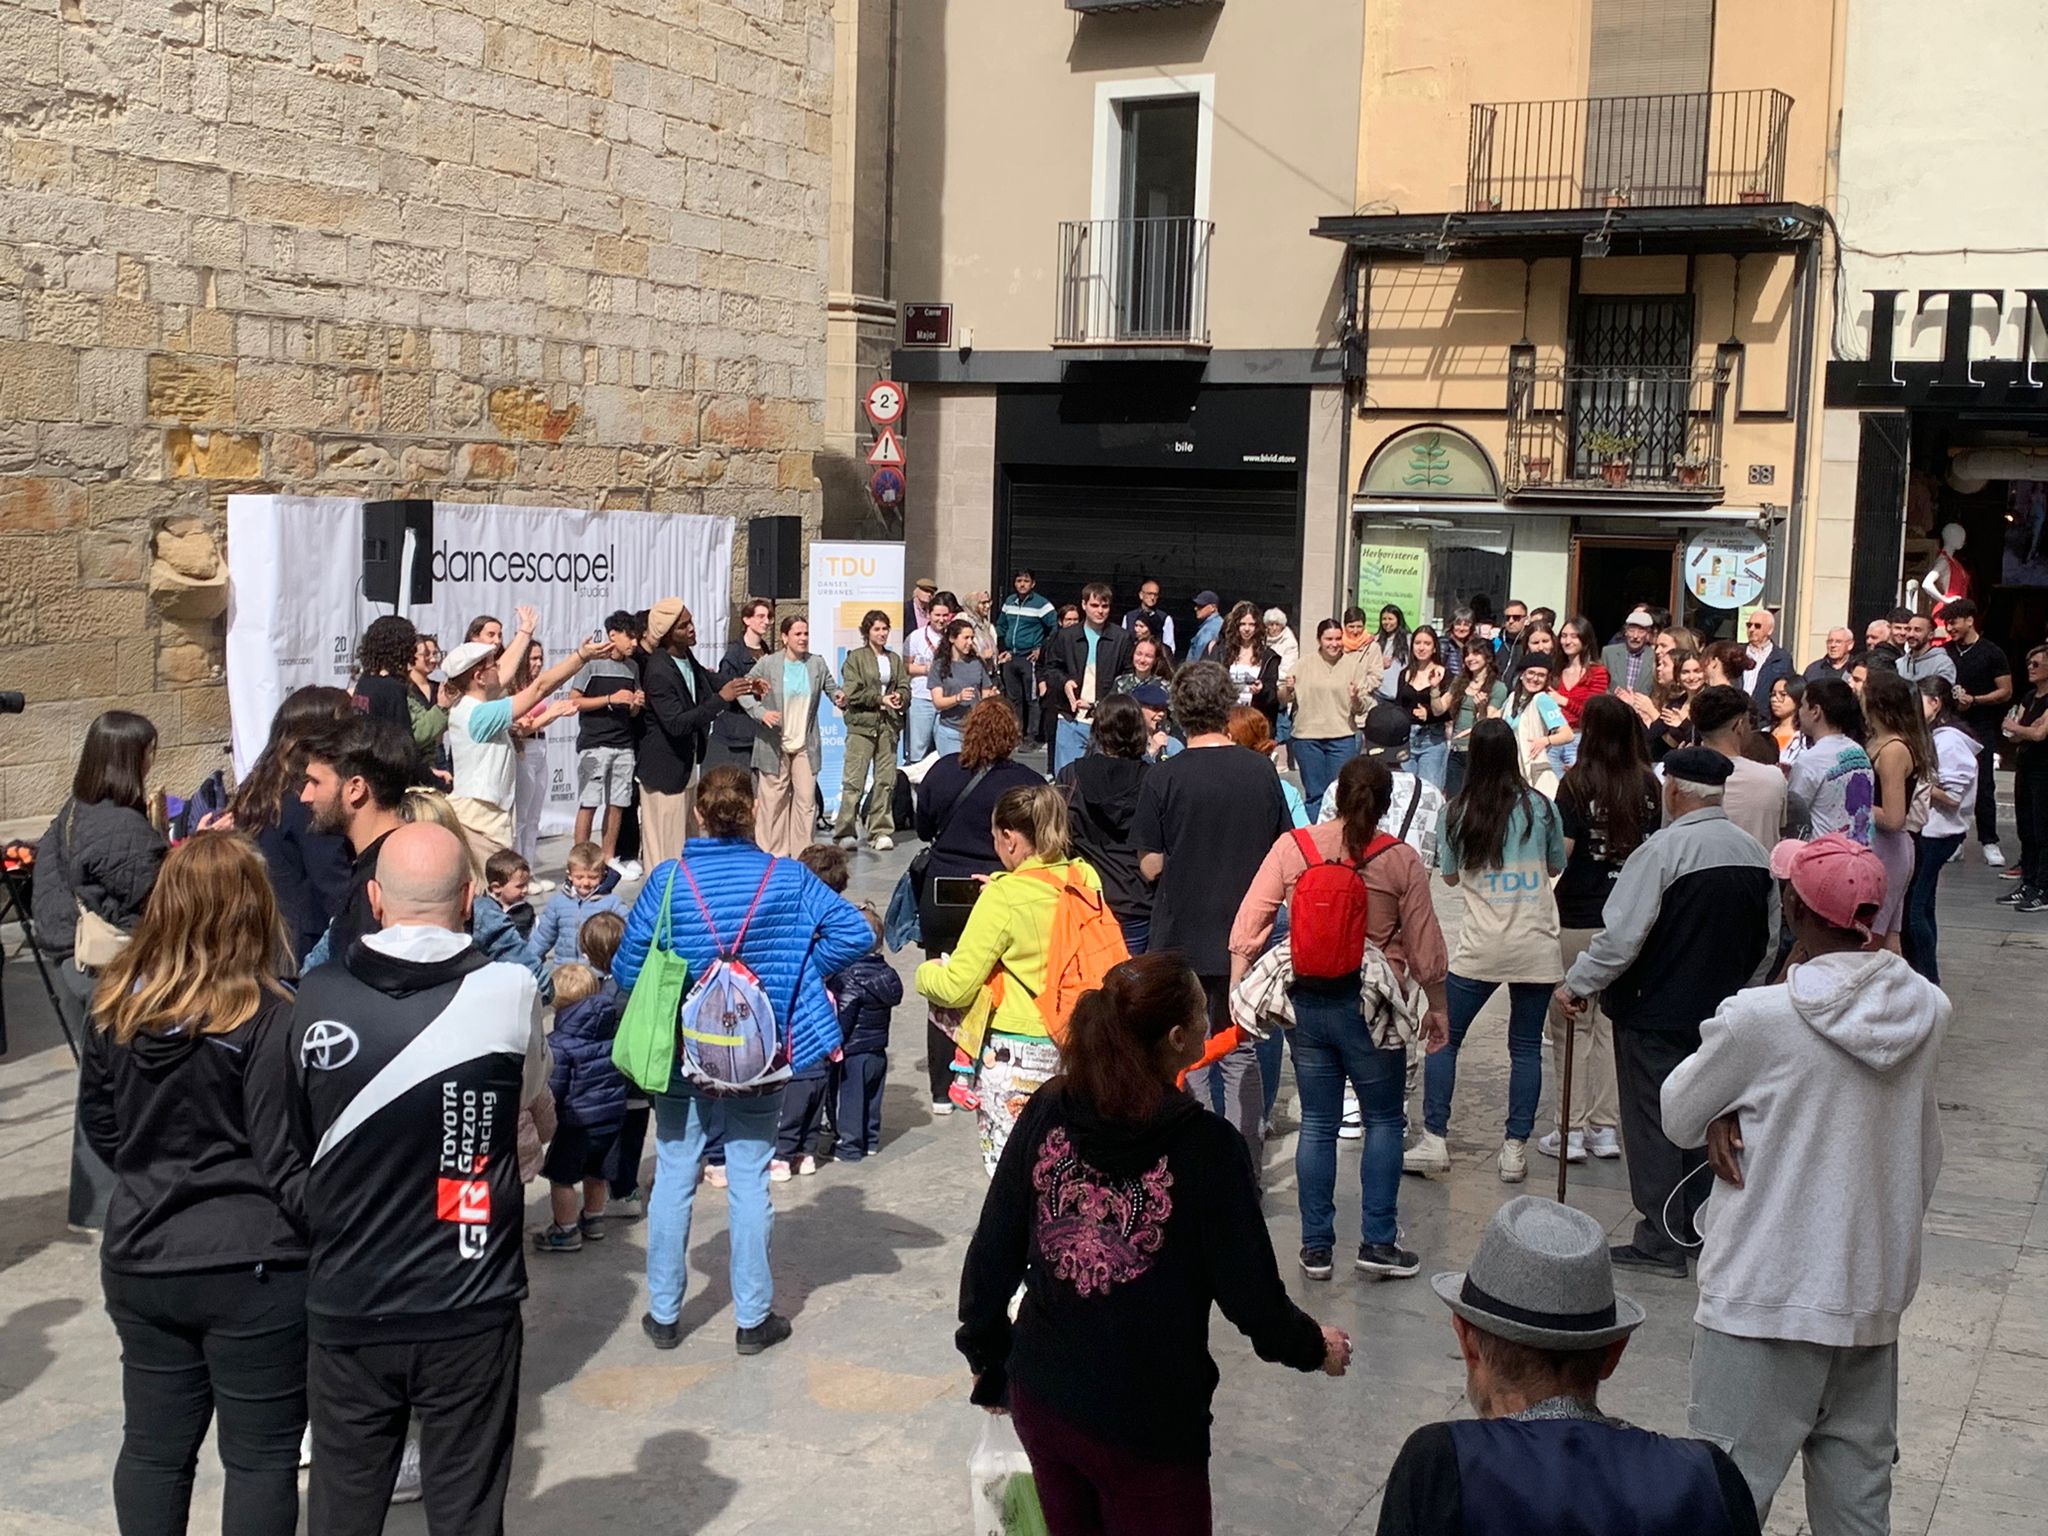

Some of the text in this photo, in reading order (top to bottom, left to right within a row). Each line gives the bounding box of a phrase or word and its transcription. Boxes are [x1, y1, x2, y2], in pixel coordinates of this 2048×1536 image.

[916, 330, 936, 341] Major
[880, 394, 889, 409] 2
[1175, 441, 1194, 452] bile
[1750, 465, 1772, 483] 88
[1362, 547, 1420, 561] Herboristeria
[431, 539, 614, 592] dancescape!
[825, 556, 876, 577] TDU
[1378, 564, 1418, 576] Albareda
[334, 636, 347, 652] 20
[1483, 871, 1539, 893] TDU
[440, 1081, 458, 1172] TOYOTA
[458, 1090, 476, 1173] GAZOO
[473, 1091, 497, 1174] Racing
[458, 1181, 488, 1259] GR
